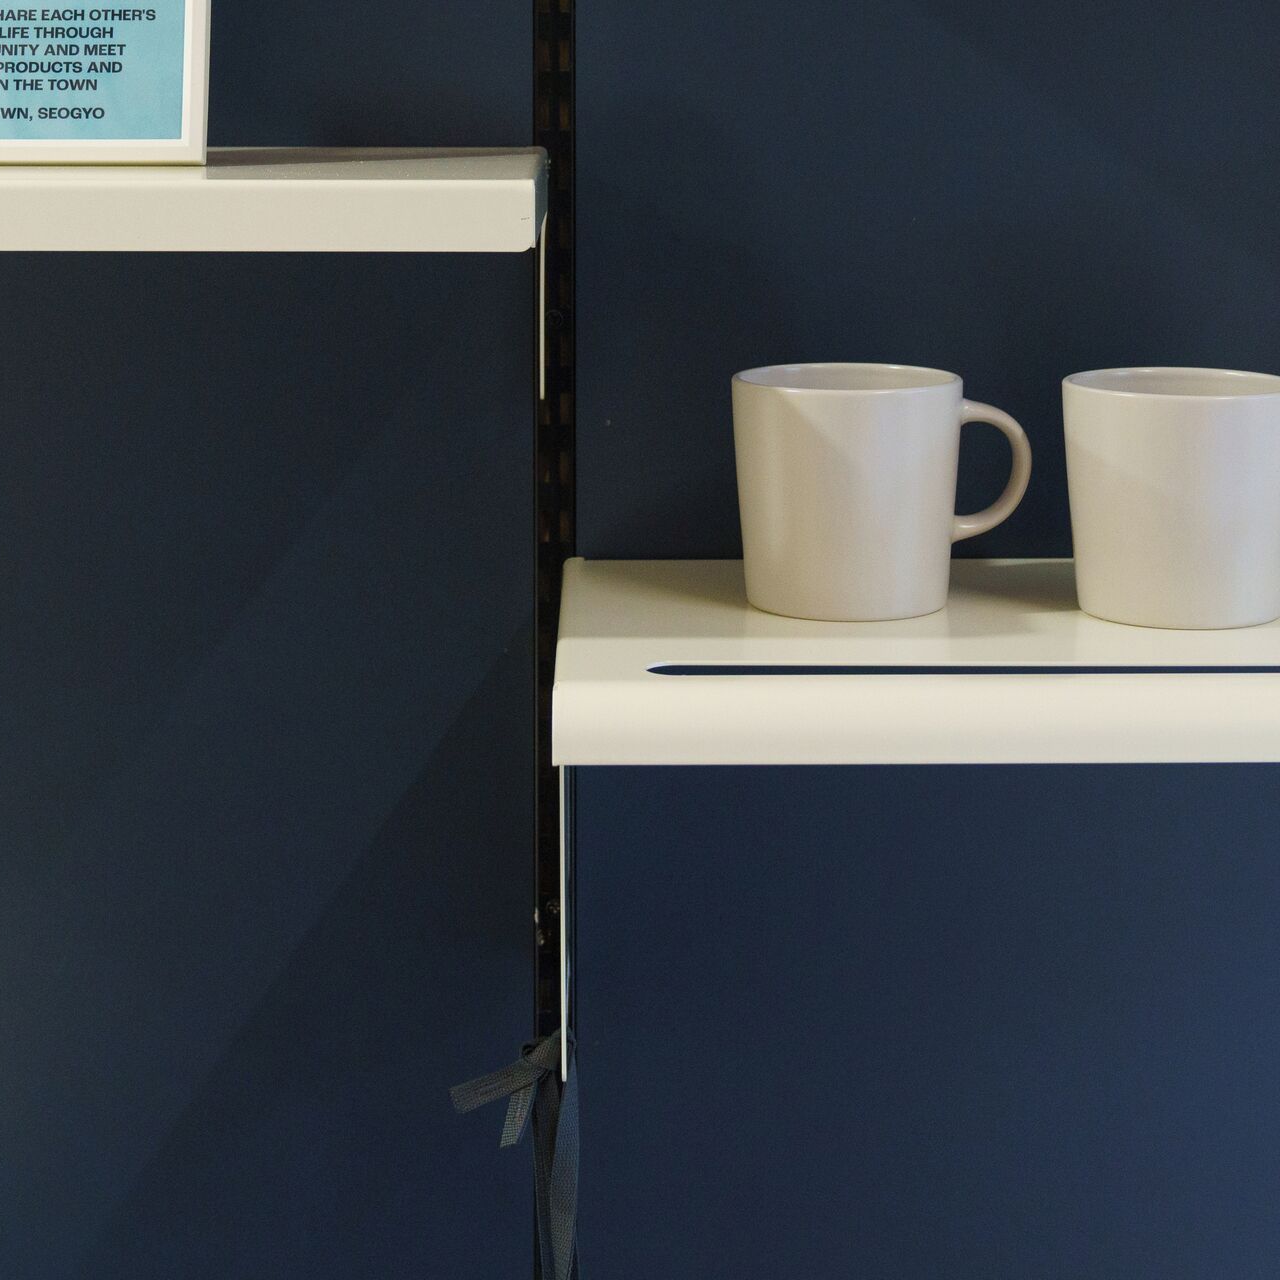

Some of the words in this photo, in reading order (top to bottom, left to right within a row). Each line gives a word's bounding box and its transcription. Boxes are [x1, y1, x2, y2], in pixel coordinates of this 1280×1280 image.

[42, 10, 84, 20] EACH
[89, 9, 155, 21] OTHER'S
[0, 27, 29, 38] LIFE
[34, 27, 113, 38] THROUGH
[44, 44, 79, 55] AND
[84, 44, 126, 55] MEET
[87, 62, 122, 73] AND
[13, 79, 43, 90] THE
[48, 79, 97, 90] TOWN
[38, 108, 104, 119] SEOGYO
